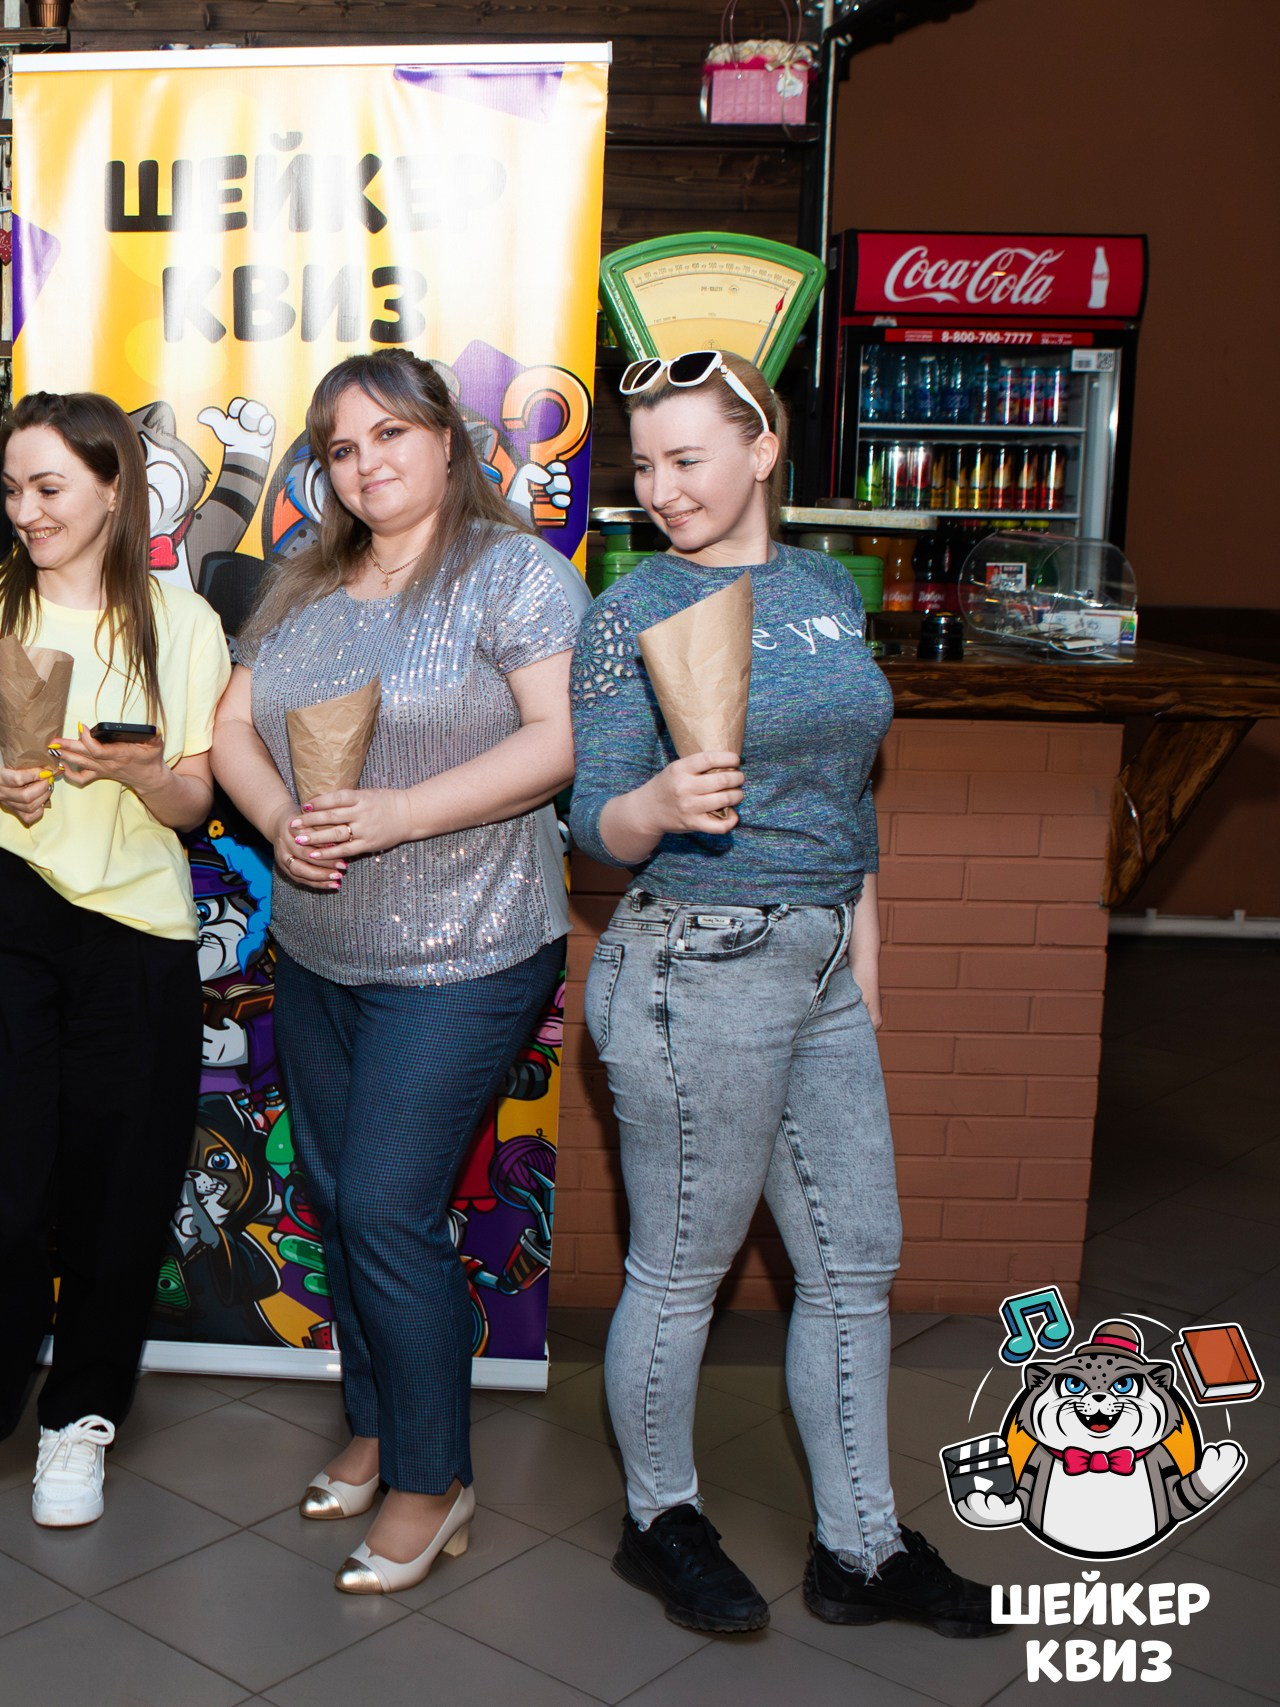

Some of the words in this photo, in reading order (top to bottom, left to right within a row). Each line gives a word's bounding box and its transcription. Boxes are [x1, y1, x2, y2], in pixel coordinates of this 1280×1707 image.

[104, 131, 508, 234] ШЕЙКЕР
[161, 263, 429, 344] КВИЗ
[884, 245, 1065, 305] Coca-Cola
[941, 330, 1033, 344] 8-800-700-7777
